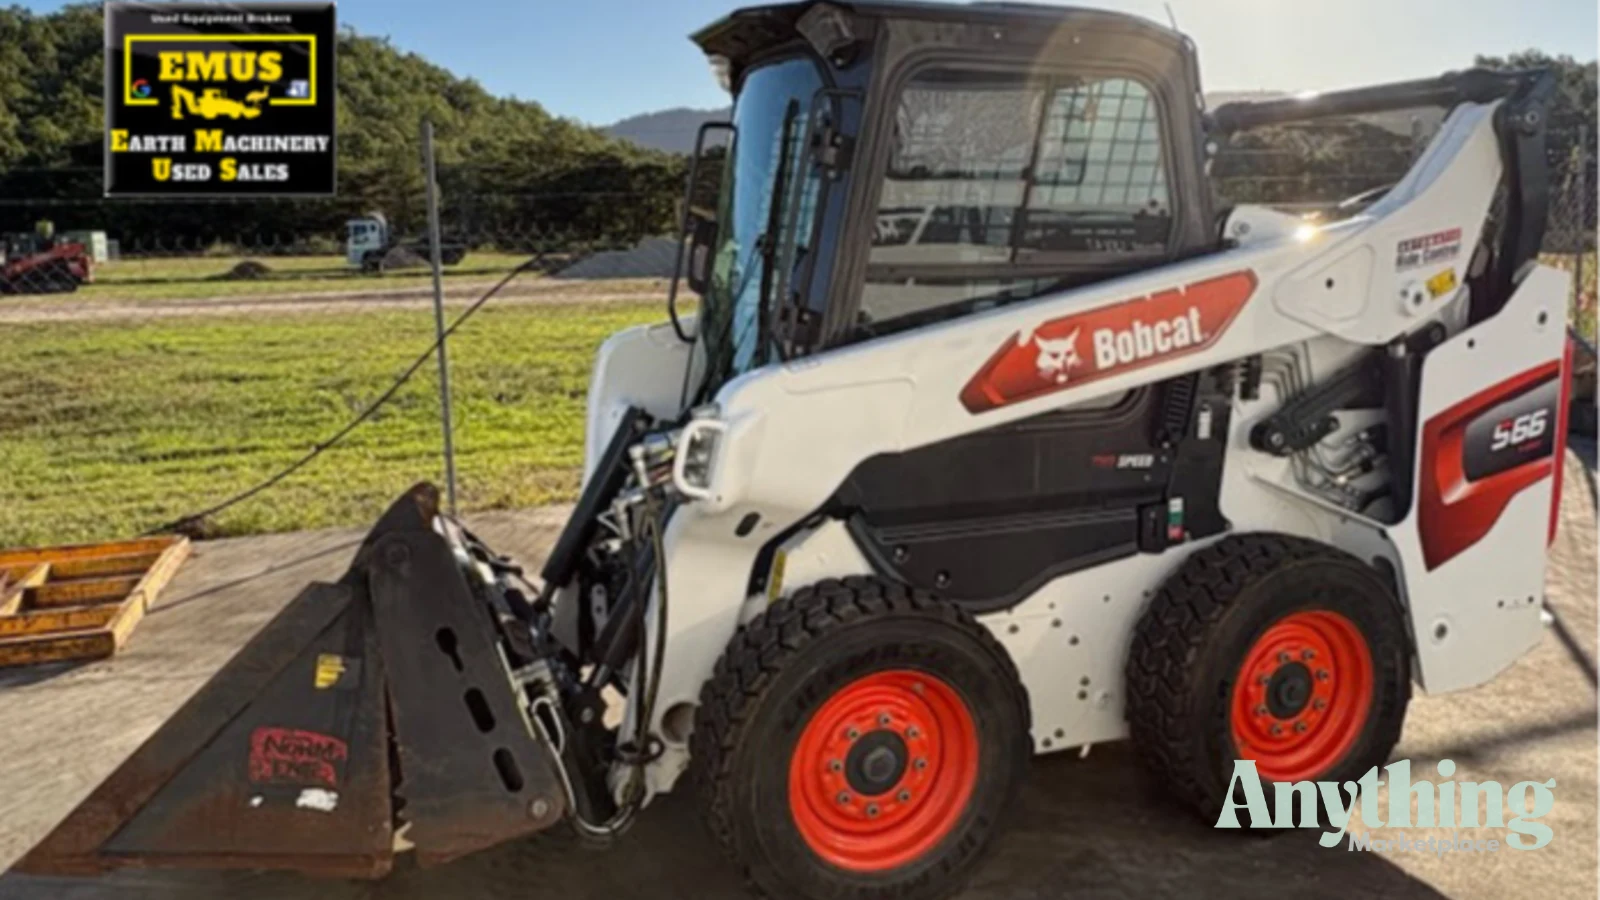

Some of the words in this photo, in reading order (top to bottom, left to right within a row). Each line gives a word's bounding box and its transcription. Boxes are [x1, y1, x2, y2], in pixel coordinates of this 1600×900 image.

[1092, 306, 1203, 369] Bobcat
[1490, 408, 1549, 452] S66
[1117, 453, 1154, 469] SPEED
